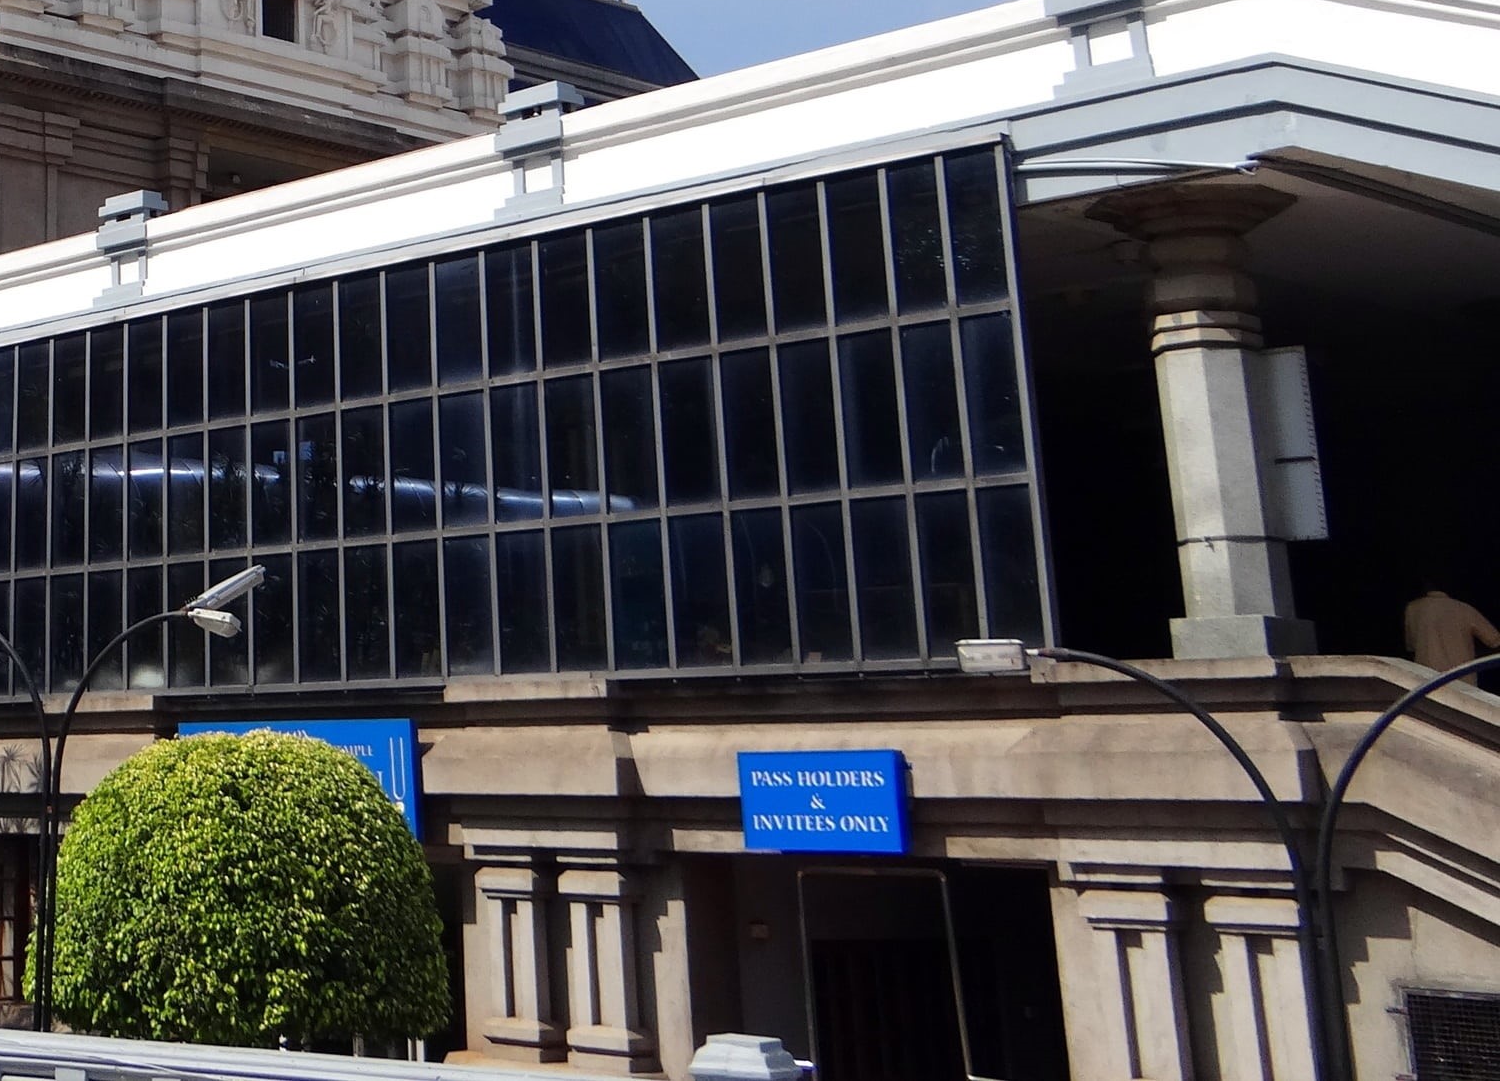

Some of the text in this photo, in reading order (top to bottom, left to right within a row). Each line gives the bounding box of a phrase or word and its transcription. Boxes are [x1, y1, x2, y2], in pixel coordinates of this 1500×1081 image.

[751, 770, 885, 787] PASS HOLDERS
[810, 792, 826, 810] &
[752, 814, 889, 833] INVITEES ONLY
